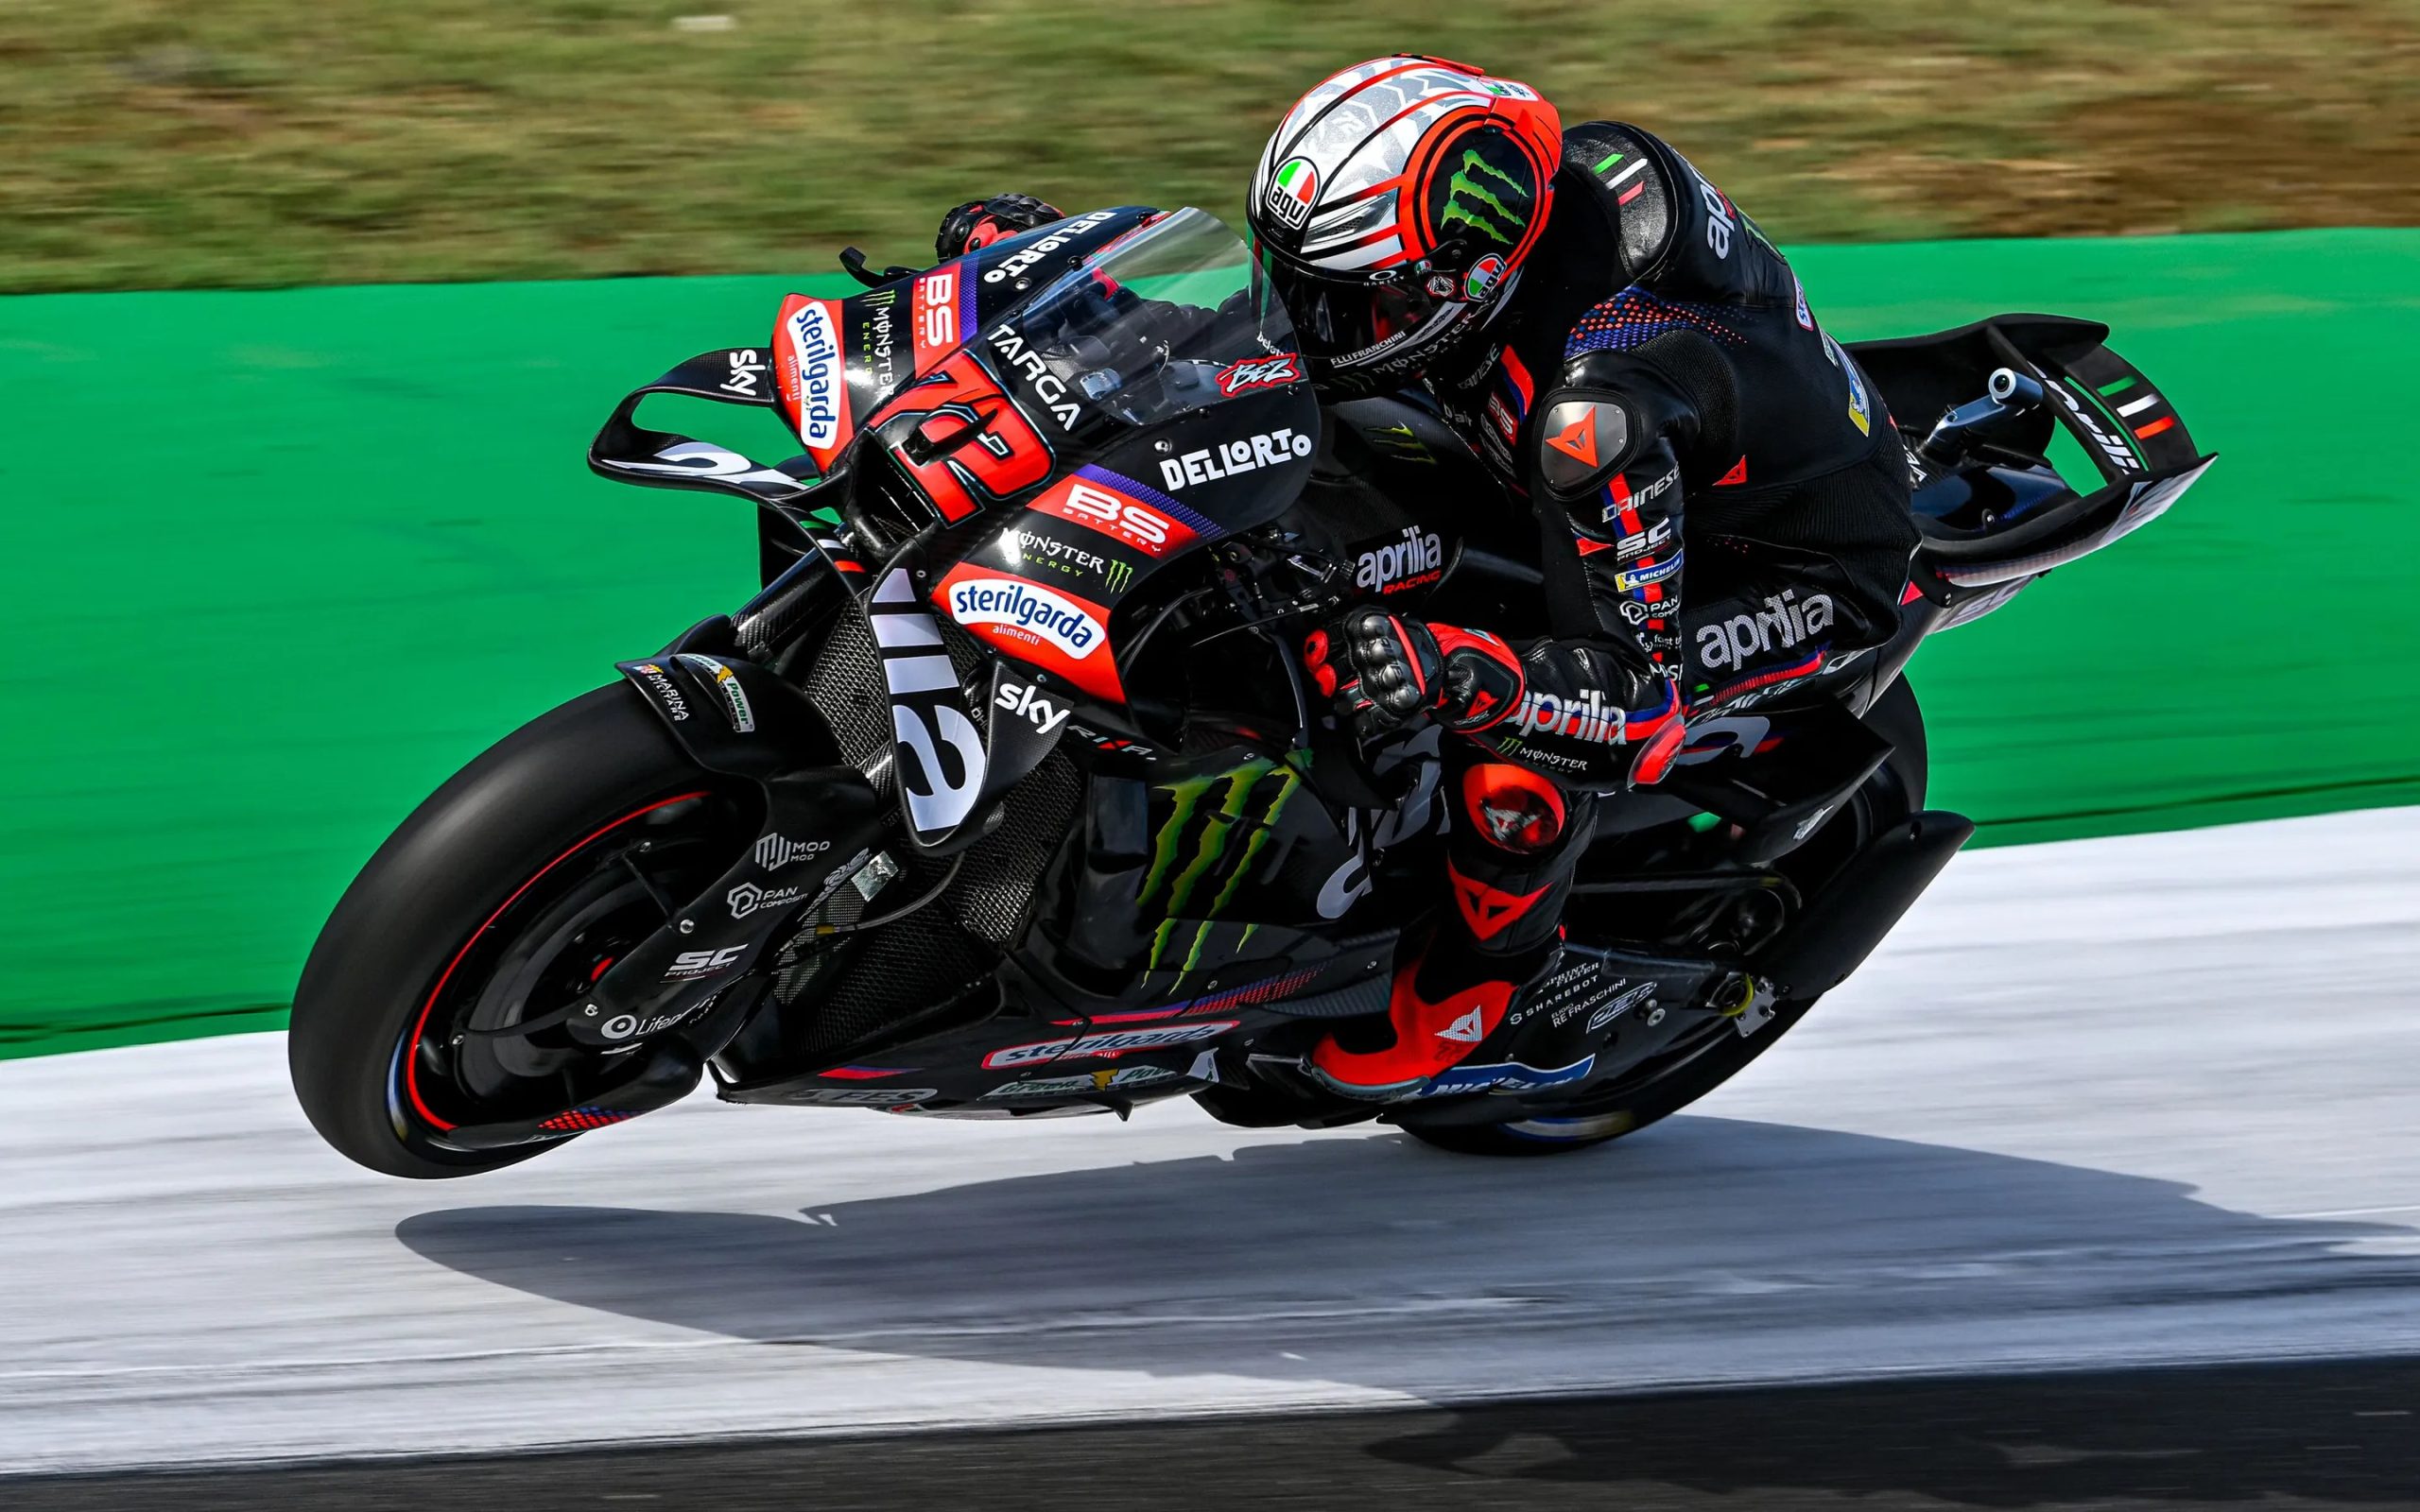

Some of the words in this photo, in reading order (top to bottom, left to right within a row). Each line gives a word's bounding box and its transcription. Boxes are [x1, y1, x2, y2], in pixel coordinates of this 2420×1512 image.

[1270, 186, 1305, 223] agv
[1478, 263, 1505, 298] agv
[918, 277, 926, 349] BATTERY
[926, 273, 953, 347] BS
[720, 349, 756, 396] sky
[796, 307, 836, 439] sterilgarda
[873, 306, 894, 401] MONSTER
[786, 354, 802, 401] alimenti
[986, 323, 1081, 432] TARGA
[1064, 484, 1170, 544] BS
[1602, 461, 1680, 523] DAINESE
[1002, 527, 1104, 574] MONSTER
[1063, 508, 1162, 553] BATTERY
[1617, 517, 1671, 556] SC
[1017, 551, 1084, 577] NERGY
[1357, 525, 1442, 593] aprilia
[1383, 569, 1442, 595] RACING
[956, 584, 1093, 649] sterilgarda
[1651, 594, 1678, 612] PAN
[993, 623, 1040, 646] alimenti
[1696, 589, 1834, 671] aprilia
[653, 674, 690, 720] MARINA
[727, 681, 749, 725] Power
[994, 682, 1071, 735] sky
[1520, 747, 1588, 771] MONSTER
[790, 852, 815, 863] MOD
[792, 841, 831, 852] MOD
[763, 886, 799, 901] PAN
[669, 944, 749, 974] SC
[1526, 974, 1599, 1017] SHAREBOT
[1552, 1013, 1567, 1028] RE
[1568, 977, 1626, 1018] FRASCHINI
